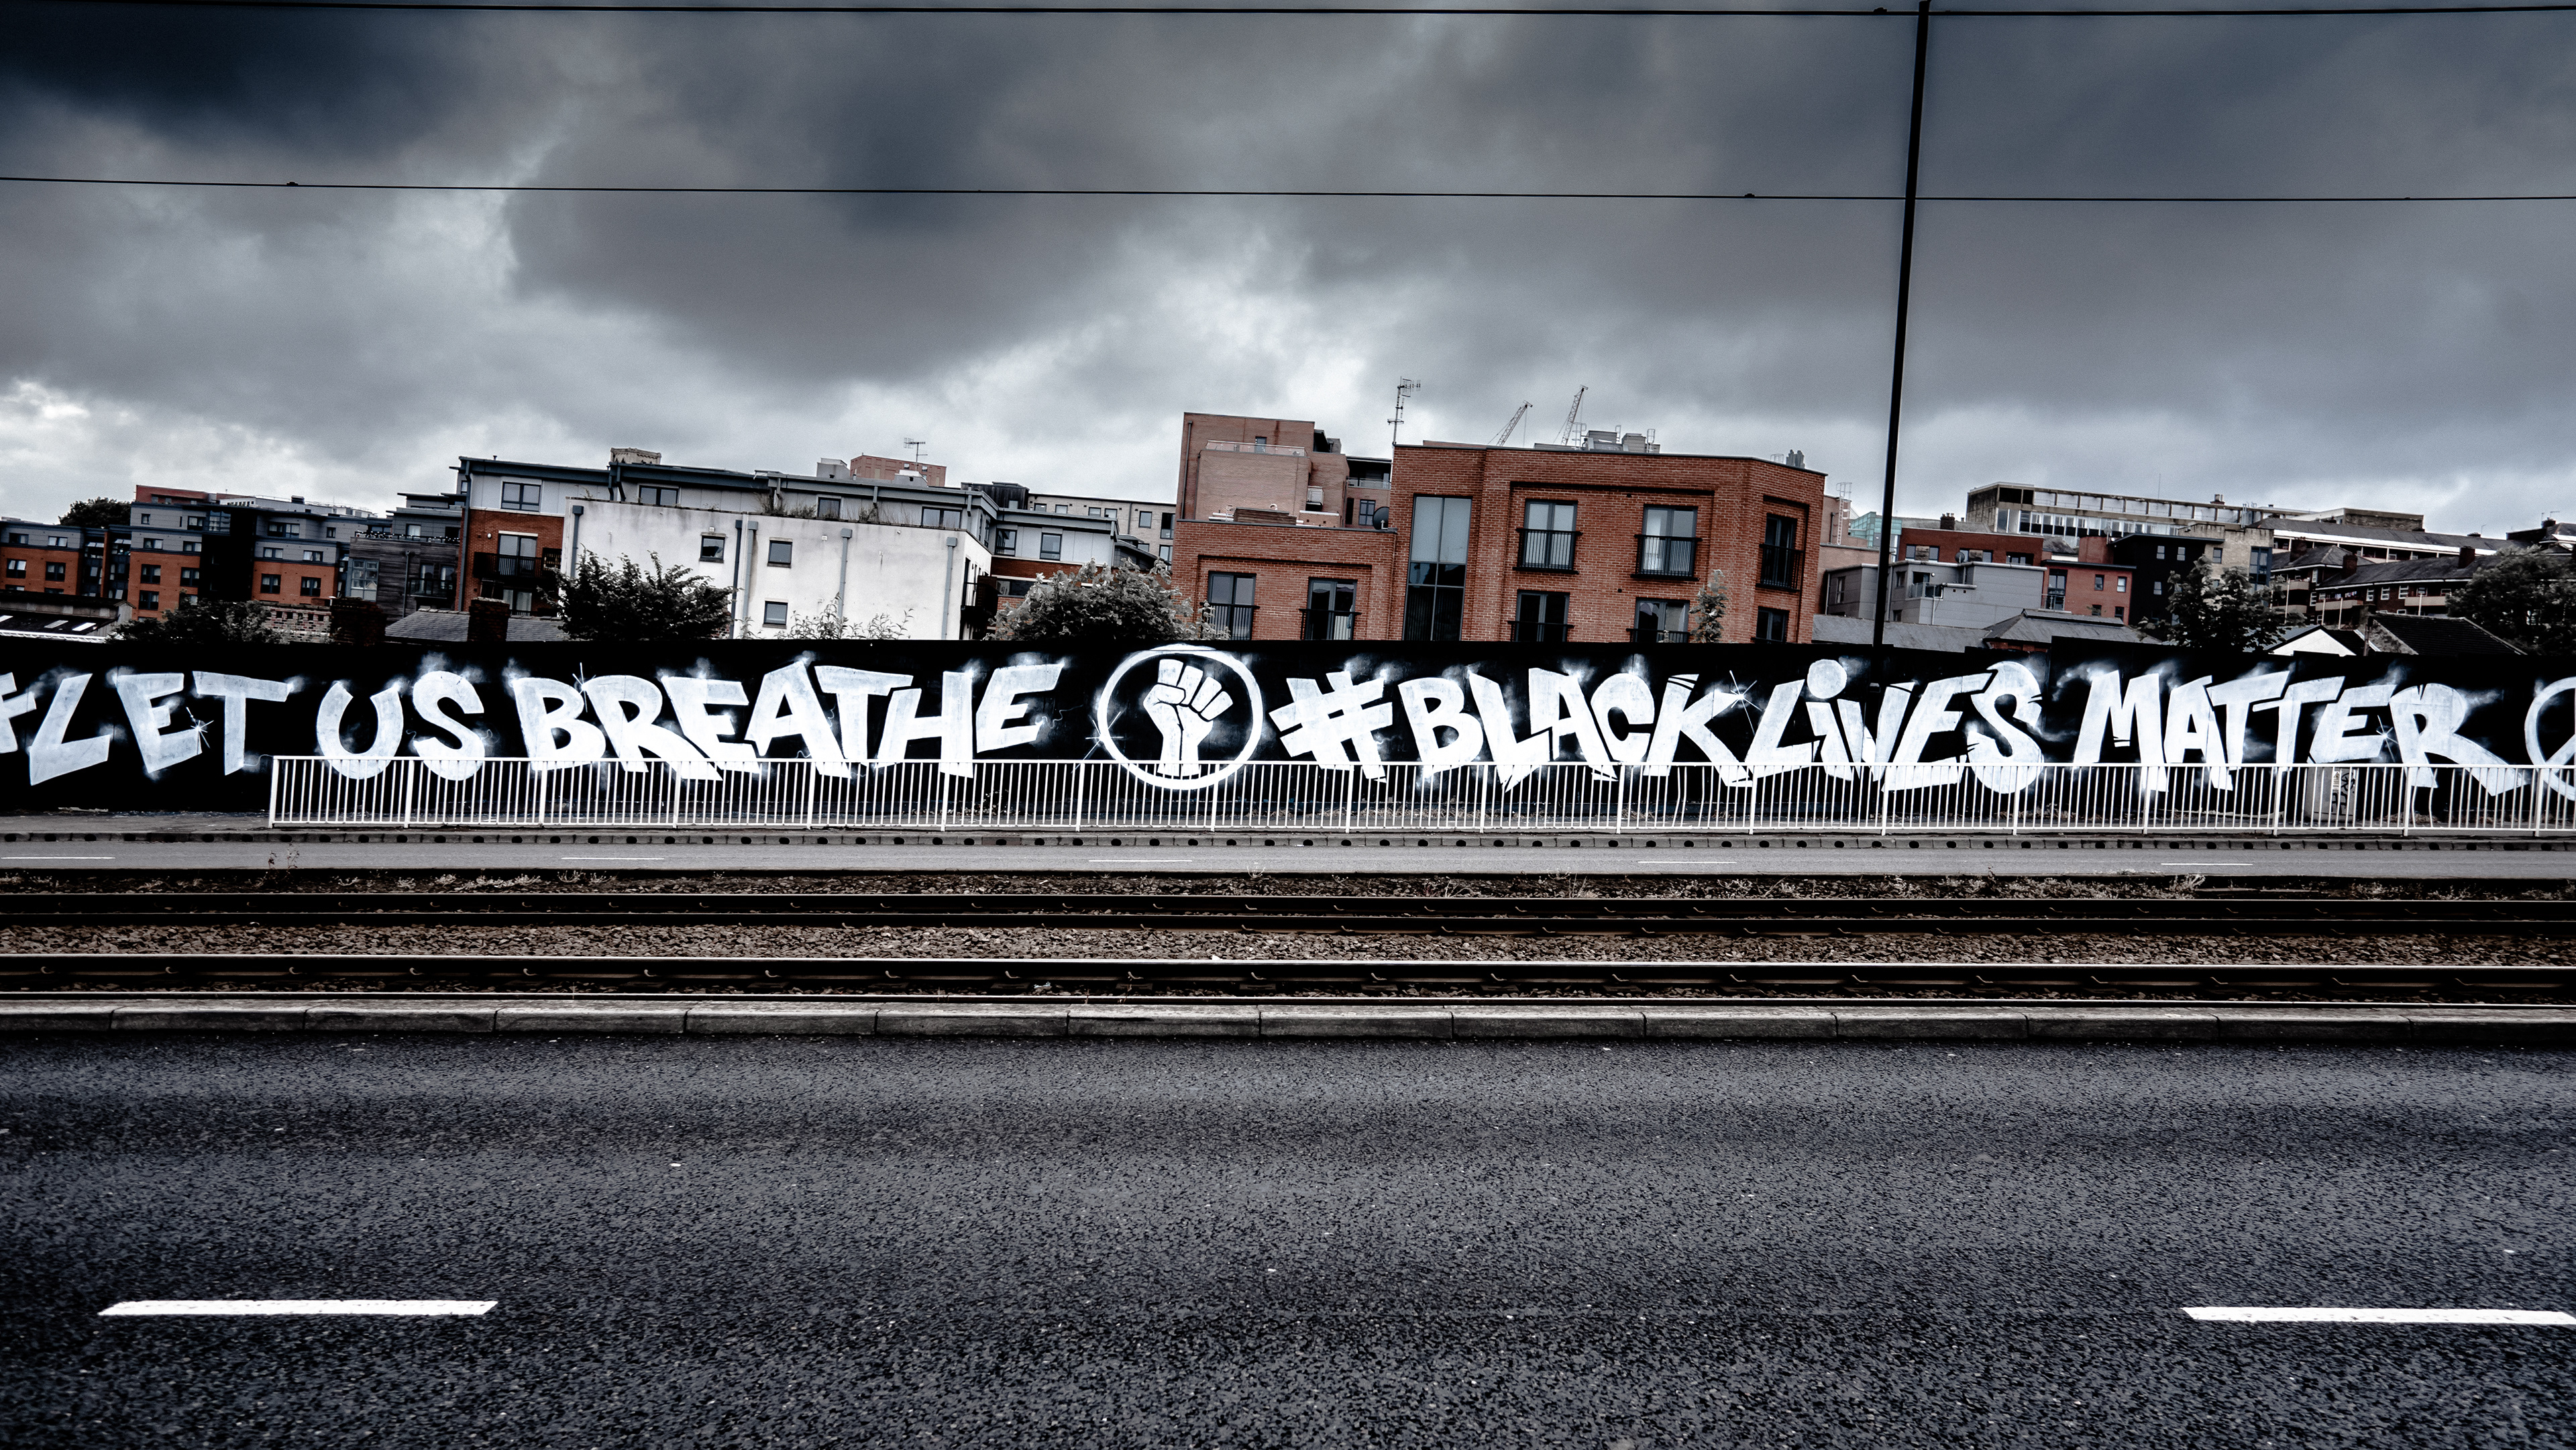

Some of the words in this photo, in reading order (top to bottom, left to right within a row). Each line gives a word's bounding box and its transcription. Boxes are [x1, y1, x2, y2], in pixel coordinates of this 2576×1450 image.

[317, 671, 484, 780] US
[513, 660, 1066, 781] BREATHE
[1269, 668, 1753, 793] #BLACK
[2073, 670, 2528, 796] MATTER
